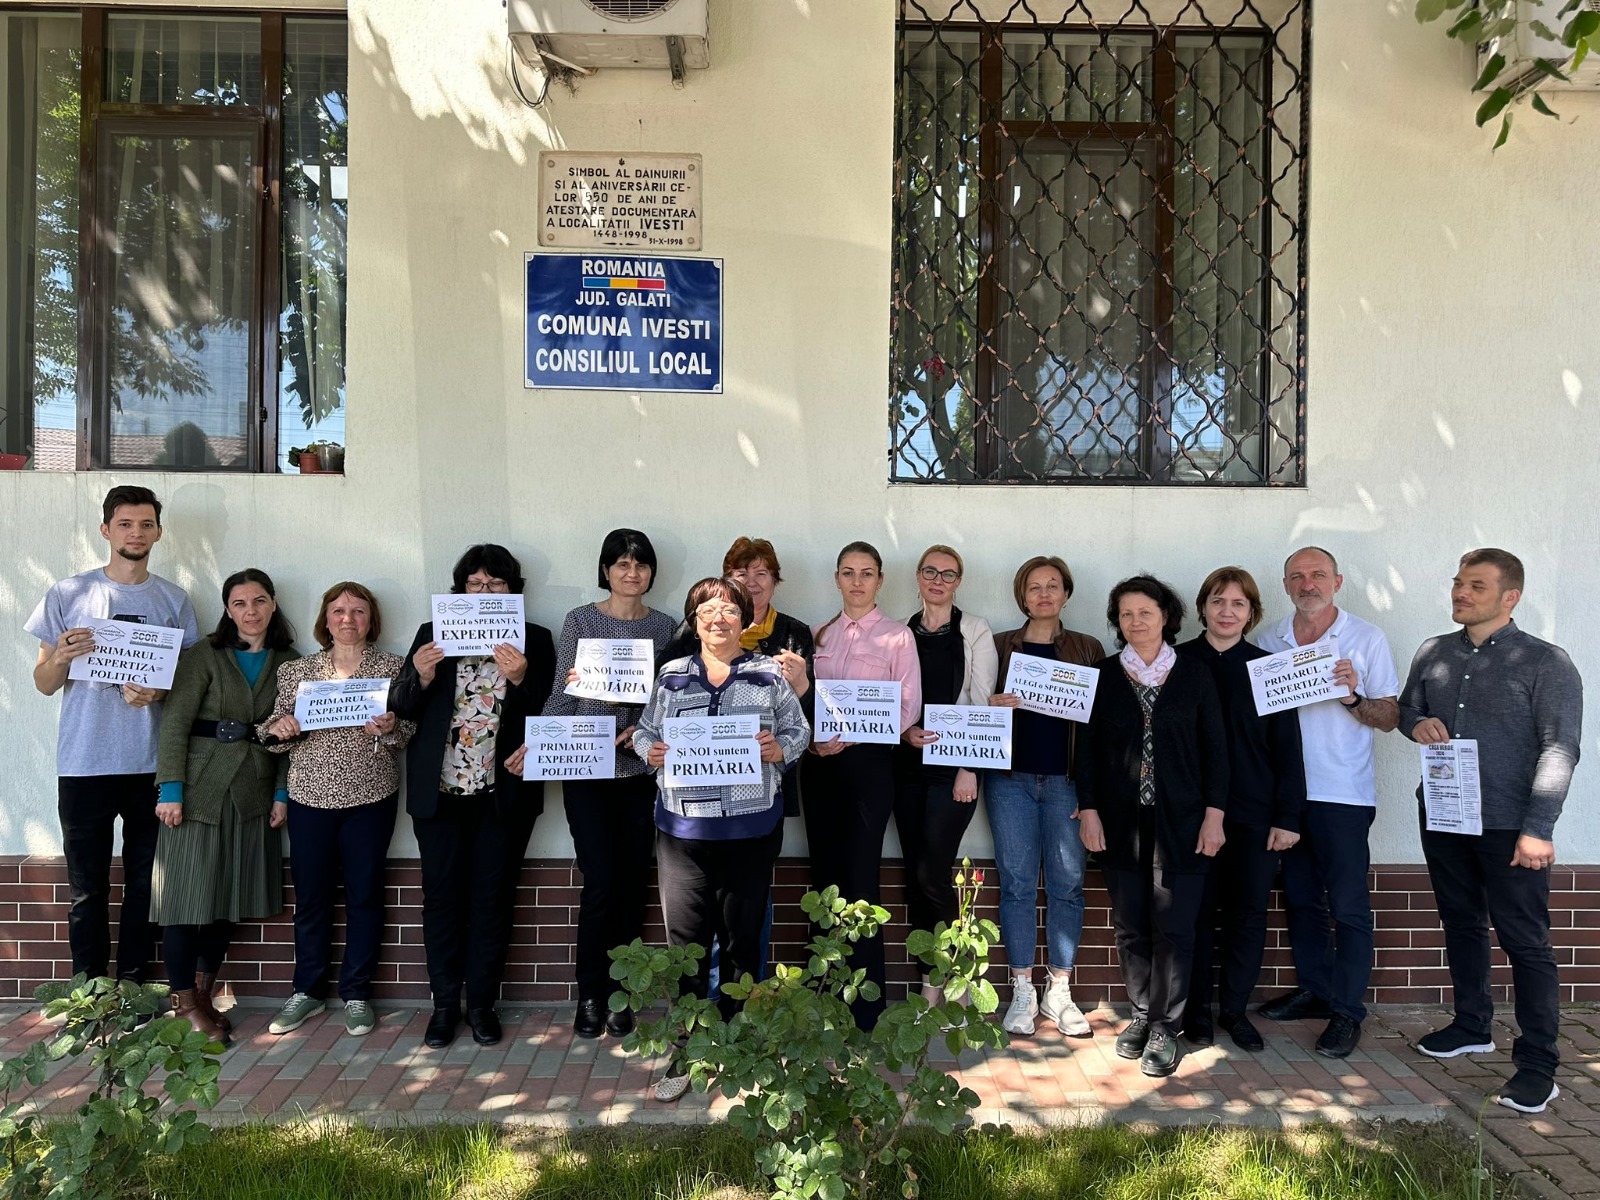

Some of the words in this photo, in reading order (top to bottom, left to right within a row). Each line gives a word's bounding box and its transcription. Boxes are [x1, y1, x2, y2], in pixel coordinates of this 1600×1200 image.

[568, 167, 610, 177] SIMBOL
[616, 168, 631, 178] AL
[571, 181, 587, 190] AL
[555, 193, 577, 202] LOR
[586, 192, 609, 203] 550
[618, 194, 633, 204] DE
[638, 195, 657, 204] ANI
[662, 196, 678, 205] DE
[546, 205, 606, 216] ATESTARE
[546, 217, 556, 228] A
[593, 230, 649, 239] 1448-1998
[649, 238, 684, 246] 31-X-1998
[582, 259, 666, 277] ROMANIA
[575, 291, 610, 306] JUD.
[616, 292, 672, 308] GALATI
[537, 314, 632, 337] COMUNA
[642, 317, 712, 340] IVESTI
[536, 348, 641, 374] CONSILIUL
[649, 351, 713, 376] LOCAL
[479, 601, 503, 610] SCOR
[131, 631, 159, 643] SCOR
[441, 628, 520, 641] EXPERTIZA
[92, 645, 157, 661] PRIMARUL
[612, 647, 634, 656] SCOR
[1292, 650, 1316, 663] SCOR
[87, 657, 164, 673] EXPERTIZA=
[594, 666, 612, 675] NOI
[614, 668, 645, 676] suntem
[90, 669, 148, 684] POLITICĂ
[1052, 668, 1076, 681] SCOR
[1264, 665, 1322, 688] PRIMARUL
[344, 683, 368, 691] SCOR
[575, 678, 647, 694] PRIMĂRIA
[1012, 677, 1037, 688] ALEGI
[857, 688, 881, 698] SCOR
[1011, 687, 1086, 711] EXPERTIZA
[309, 695, 367, 707] PRIMARUL
[836, 707, 855, 716] NOI
[858, 709, 891, 717] suntem
[1049, 707, 1064, 715] NOI
[968, 713, 991, 723] SCOR
[572, 724, 596, 733] SCOR
[712, 724, 737, 735] SCOR
[821, 719, 895, 735] PRIMĂRIA
[946, 730, 966, 740] NOI
[968, 733, 1001, 743] suntem
[540, 742, 597, 751] PRIMARUL
[676, 747, 687, 759] Și
[689, 747, 710, 757] NOI
[713, 746, 750, 756] suntem
[930, 743, 1006, 760] PRIMĂRIA
[538, 755, 605, 764] EXPERTIZA=
[541, 765, 593, 776] POLITICĂ
[672, 759, 756, 776] PRIMĂRIA
